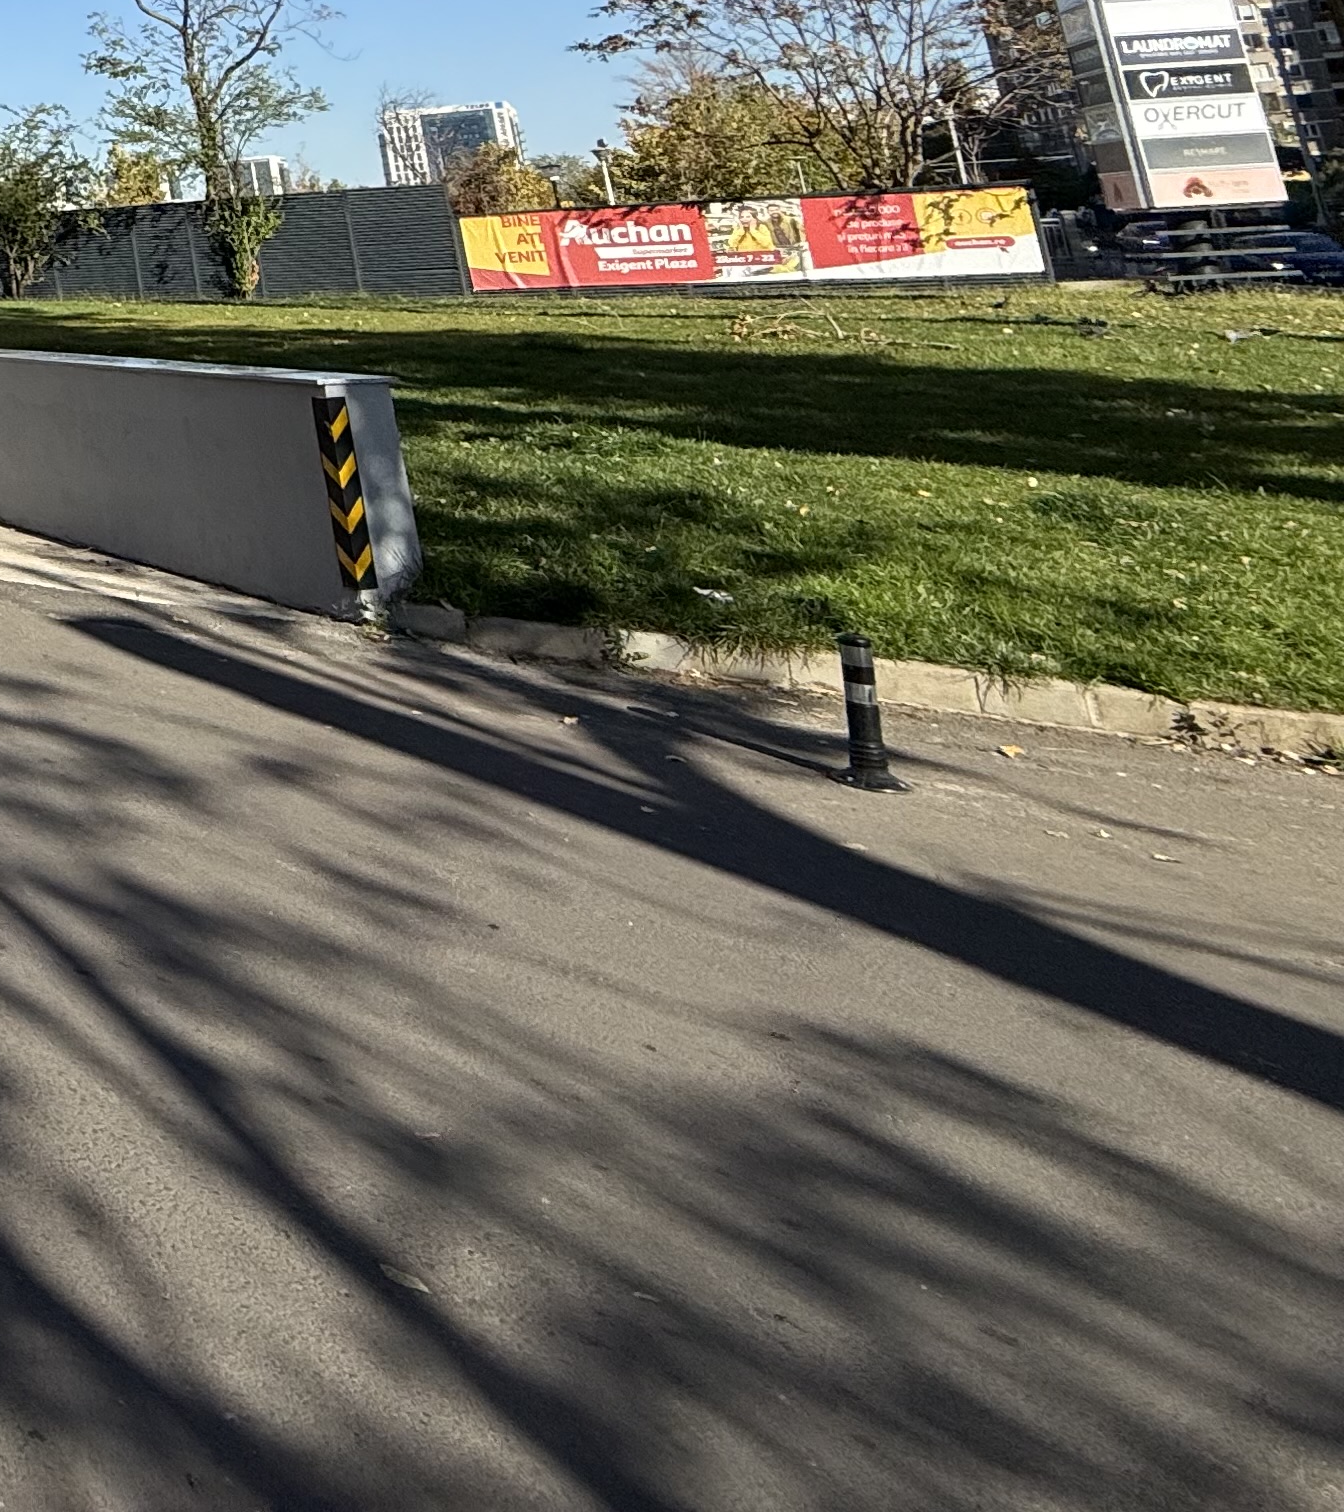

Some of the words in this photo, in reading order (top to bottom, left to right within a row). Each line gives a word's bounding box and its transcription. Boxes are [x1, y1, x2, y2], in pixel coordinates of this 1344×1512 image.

[1120, 35, 1231, 54] LAUNDROMAT
[1170, 73, 1232, 86] EXIGENT
[501, 214, 541, 228] BINE
[559, 219, 692, 247] Auchan
[495, 250, 545, 264] VENIT
[598, 260, 653, 274] Exigent
[654, 258, 698, 269] Plaza
